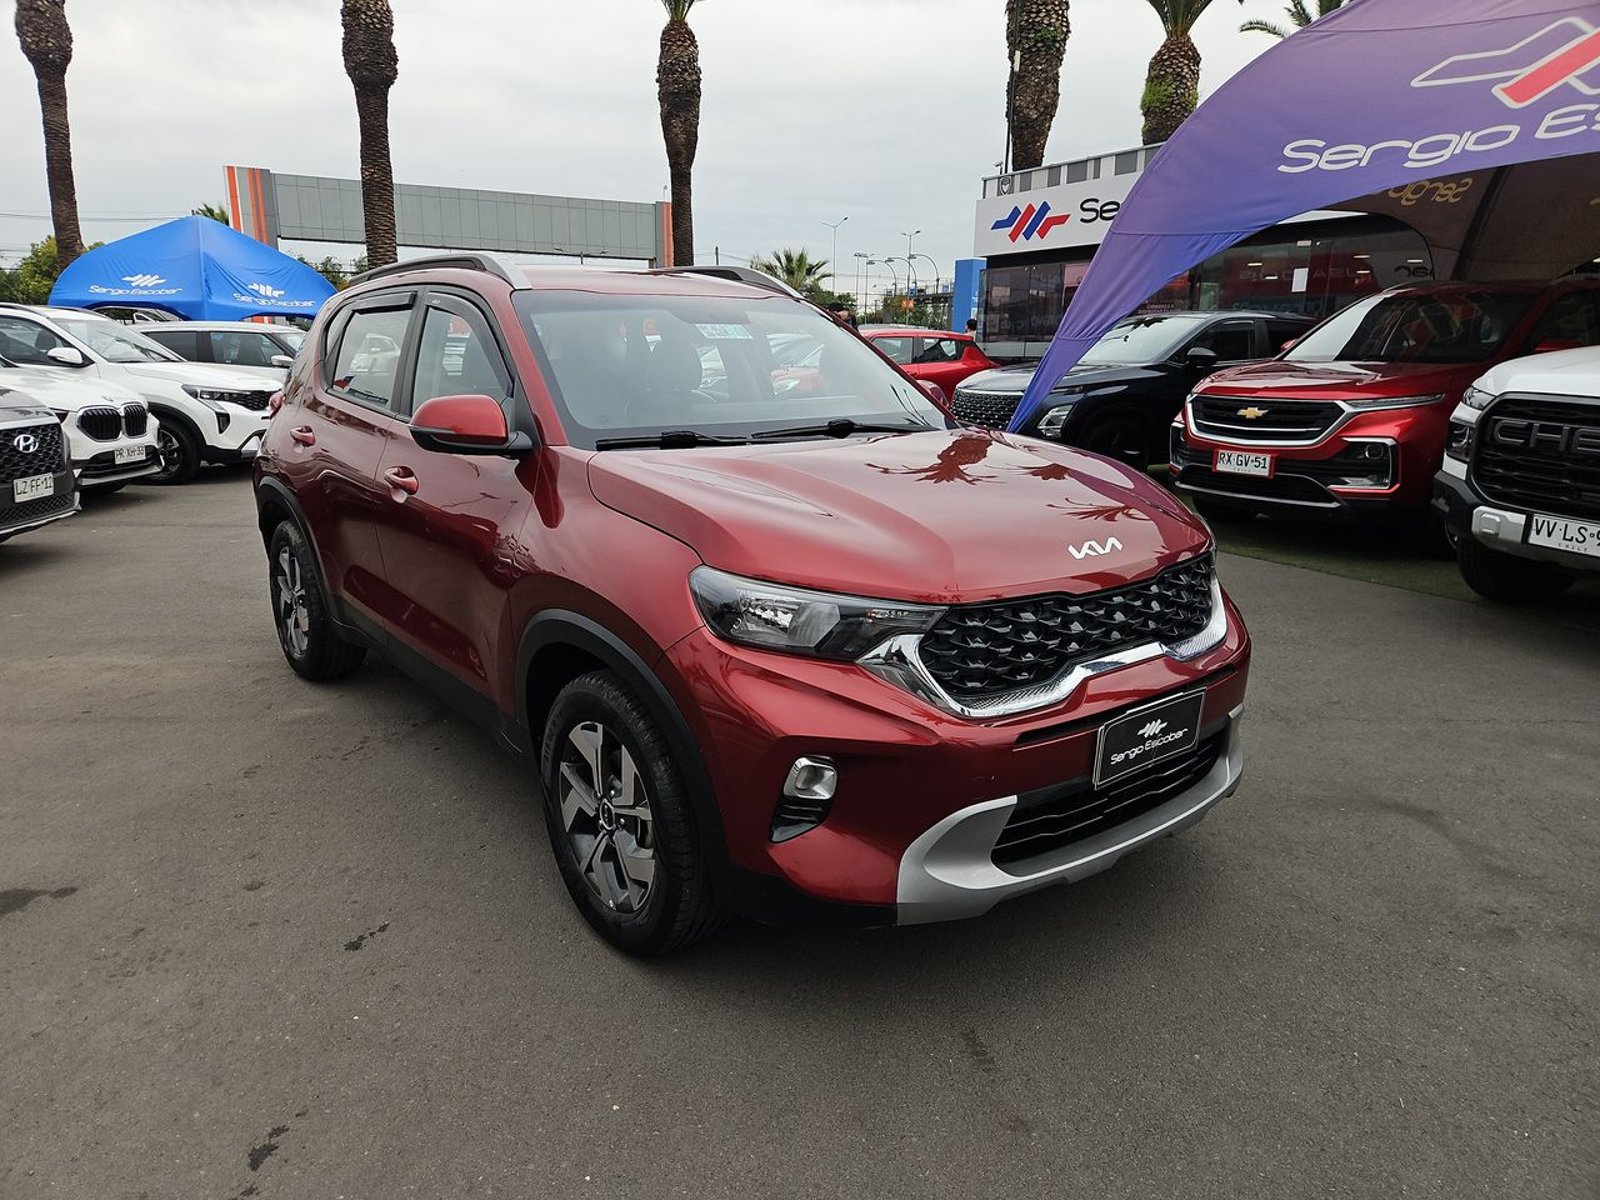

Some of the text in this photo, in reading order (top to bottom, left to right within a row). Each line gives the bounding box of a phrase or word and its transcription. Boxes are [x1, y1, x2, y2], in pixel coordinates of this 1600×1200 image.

[1277, 103, 1600, 173] Sergio E
[1068, 536, 1123, 560] KIA
[1110, 728, 1189, 765] Sergio Escobar
